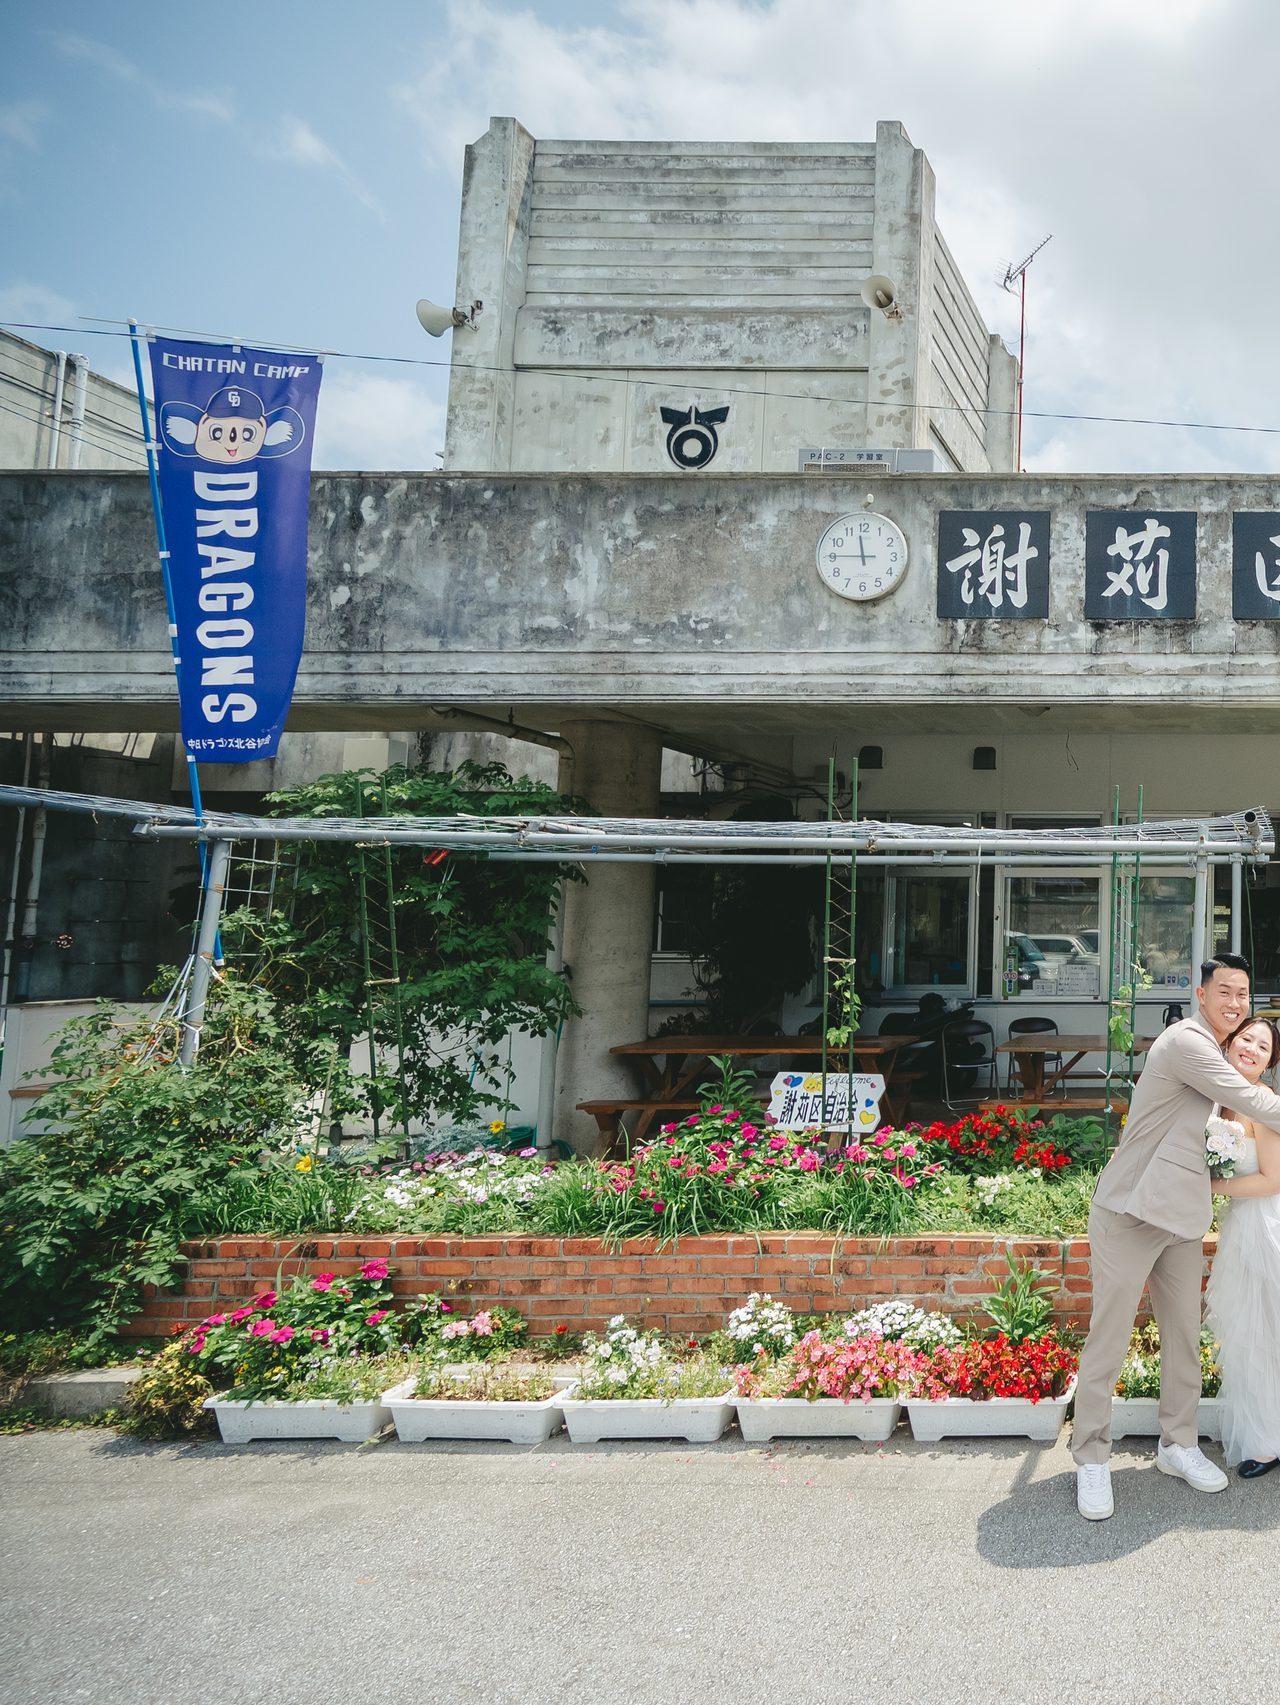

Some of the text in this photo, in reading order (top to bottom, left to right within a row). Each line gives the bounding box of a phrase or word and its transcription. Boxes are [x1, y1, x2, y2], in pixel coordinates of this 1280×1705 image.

[163, 352, 310, 379] CHATAN CAMP
[856, 452, 883, 461] 学習室
[845, 527, 854, 537] 11
[858, 523, 870, 533] 12
[877, 527, 882, 537] 1
[832, 538, 844, 548] 10
[886, 537, 894, 547] 2
[829, 552, 837, 562] 9
[890, 552, 898, 562] 3
[832, 567, 841, 577] 8
[886, 567, 893, 577] 4
[844, 578, 851, 588] 7
[859, 582, 867, 592] 6
[874, 577, 882, 588] 5
[193, 471, 259, 724] DRAGONS
